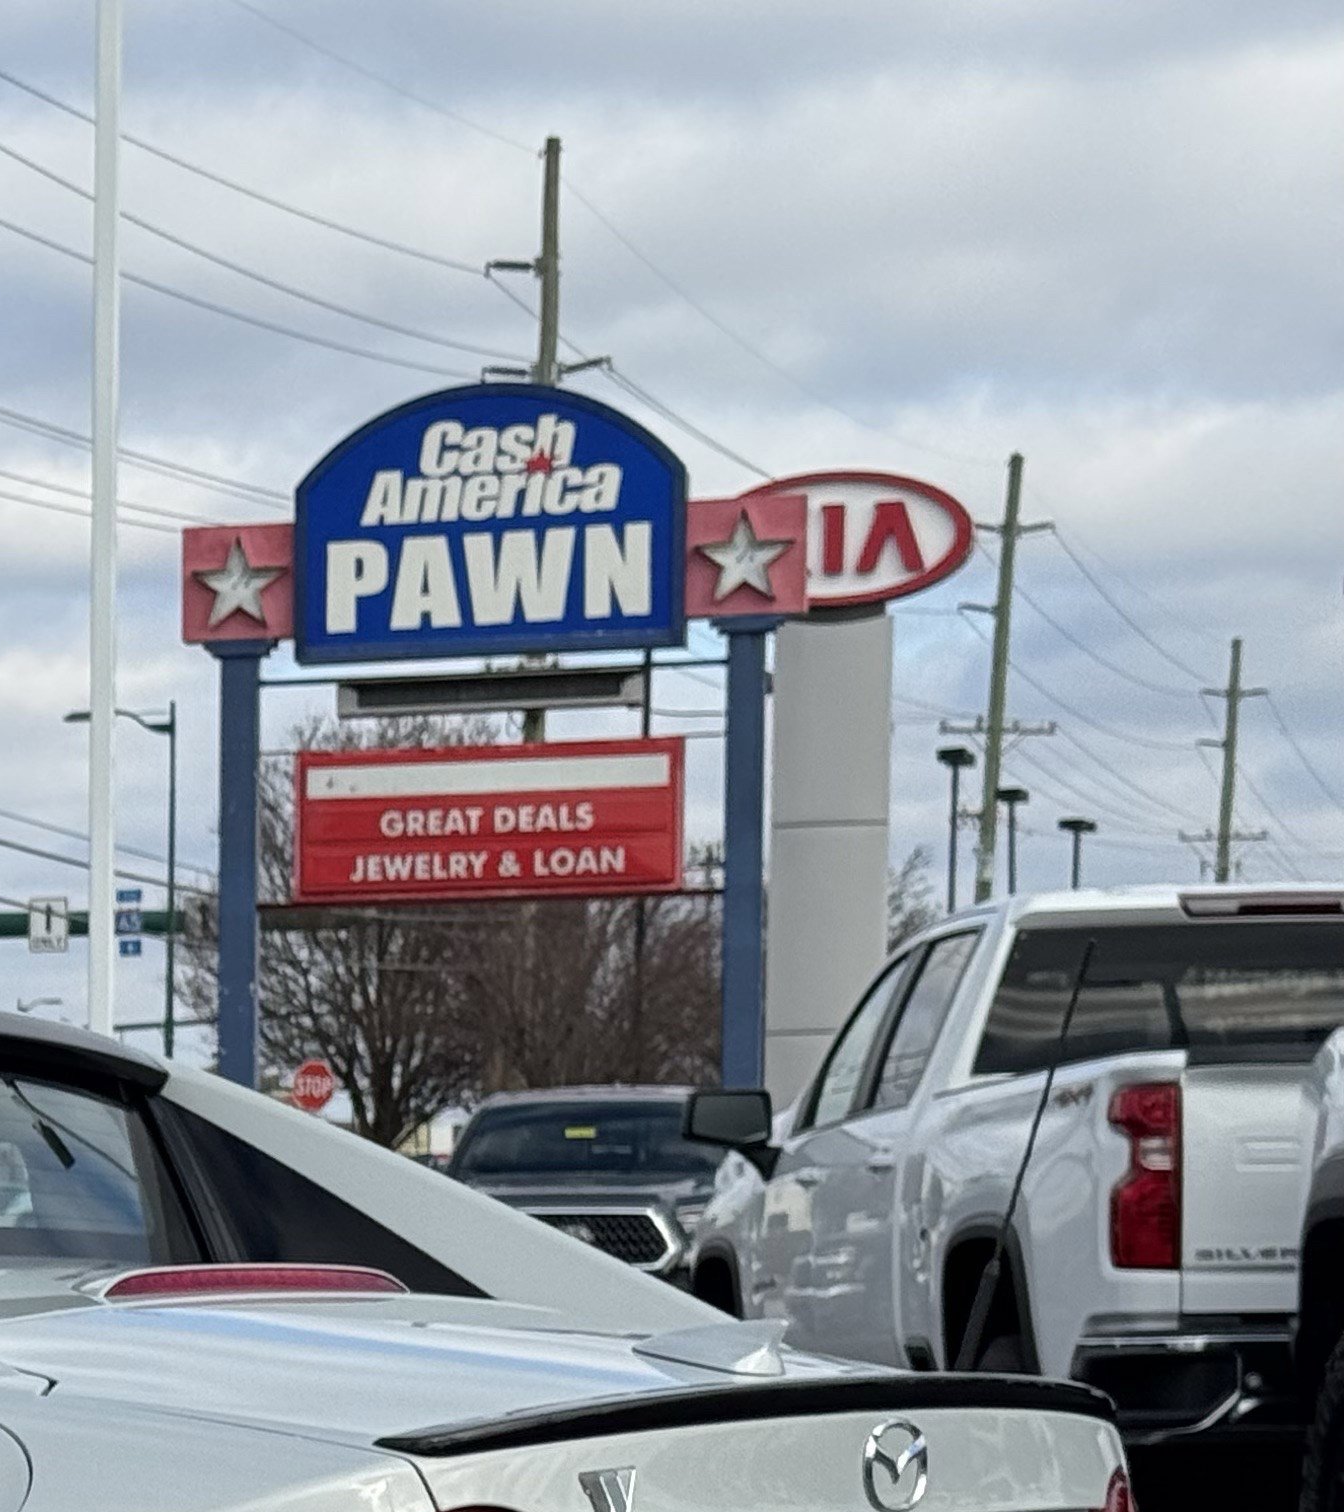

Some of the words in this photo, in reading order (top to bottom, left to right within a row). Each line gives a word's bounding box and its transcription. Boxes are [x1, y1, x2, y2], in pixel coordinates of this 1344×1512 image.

[419, 413, 576, 478] Cash
[360, 463, 623, 527] America
[822, 501, 924, 575] IA
[326, 520, 652, 634] PAWN
[379, 806, 484, 838] GREAT
[493, 802, 595, 833] DEALS
[350, 851, 488, 883] JEWELRY
[498, 851, 520, 877] &
[534, 847, 626, 877] LOAN
[295, 1075, 332, 1098] STOP
